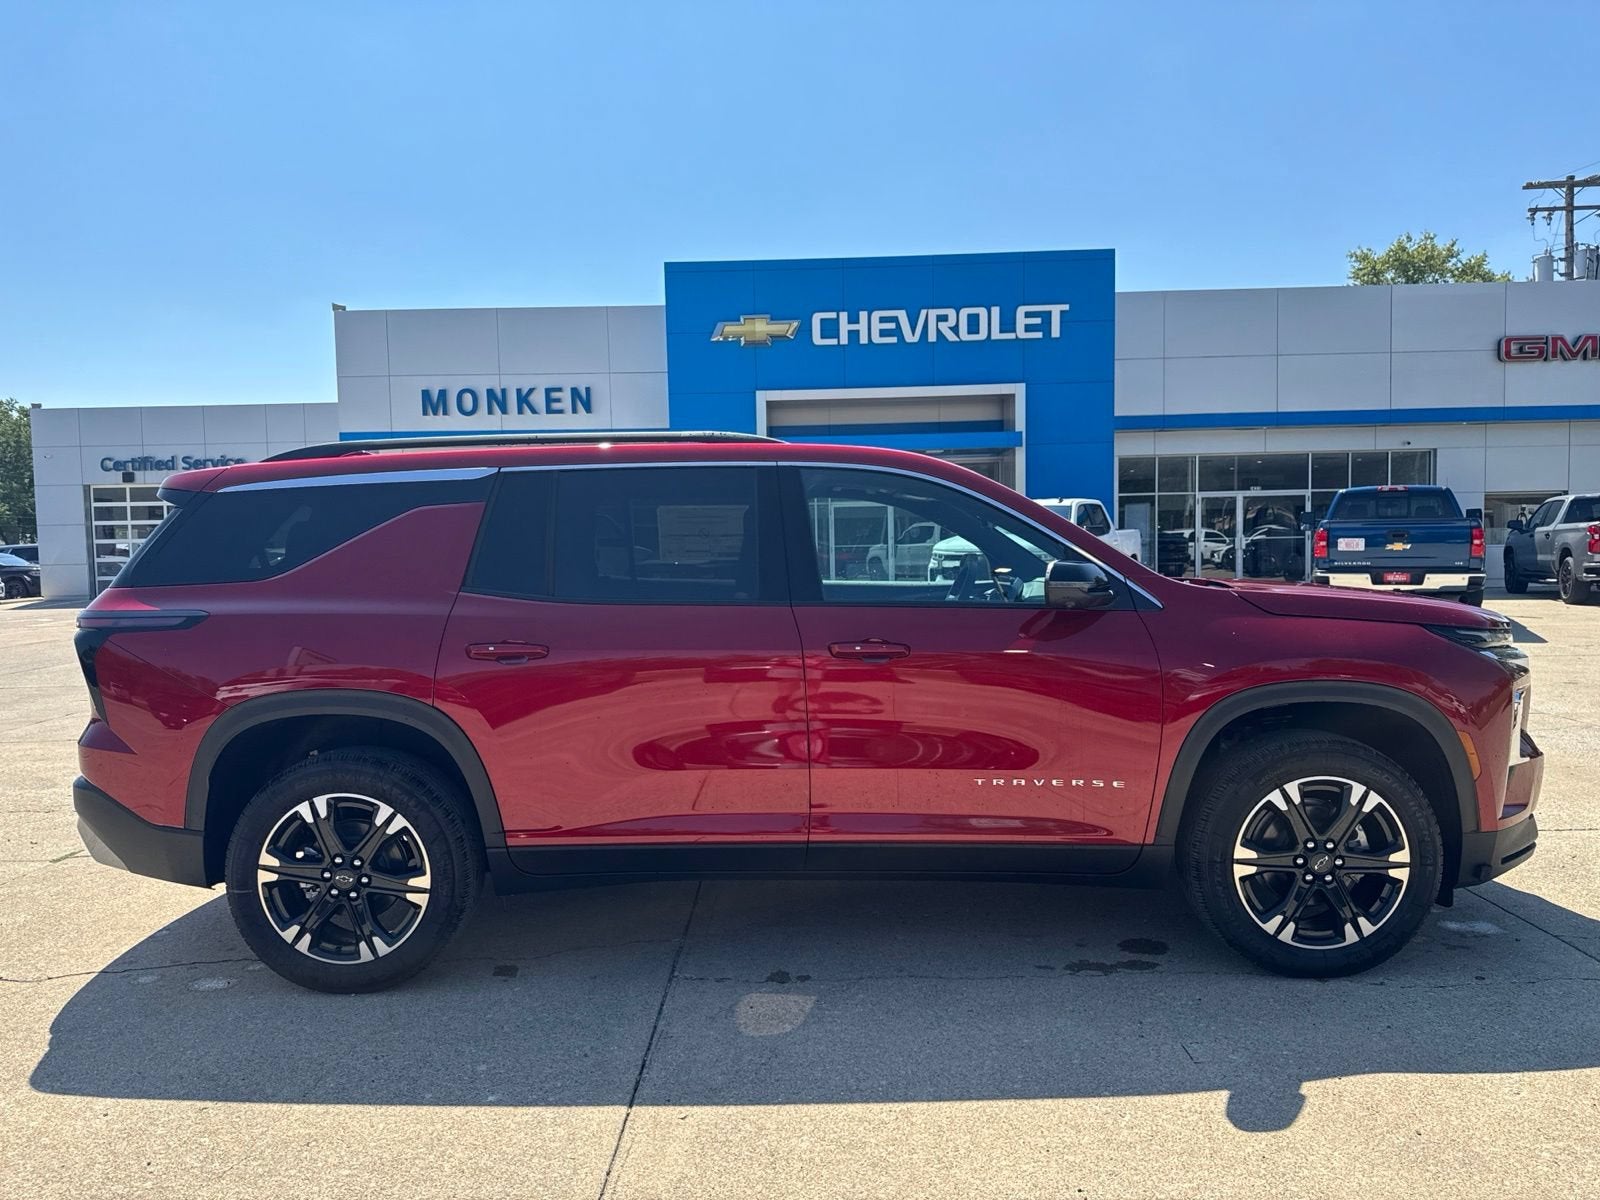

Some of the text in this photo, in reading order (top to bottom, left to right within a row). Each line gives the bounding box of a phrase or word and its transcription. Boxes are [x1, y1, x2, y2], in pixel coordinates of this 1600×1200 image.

[811, 303, 1070, 346] CHEVROLET
[1498, 334, 1600, 362] GM
[421, 386, 593, 416] MONKEN
[100, 455, 177, 472] Certified
[974, 778, 1126, 788] TRAVERSE
